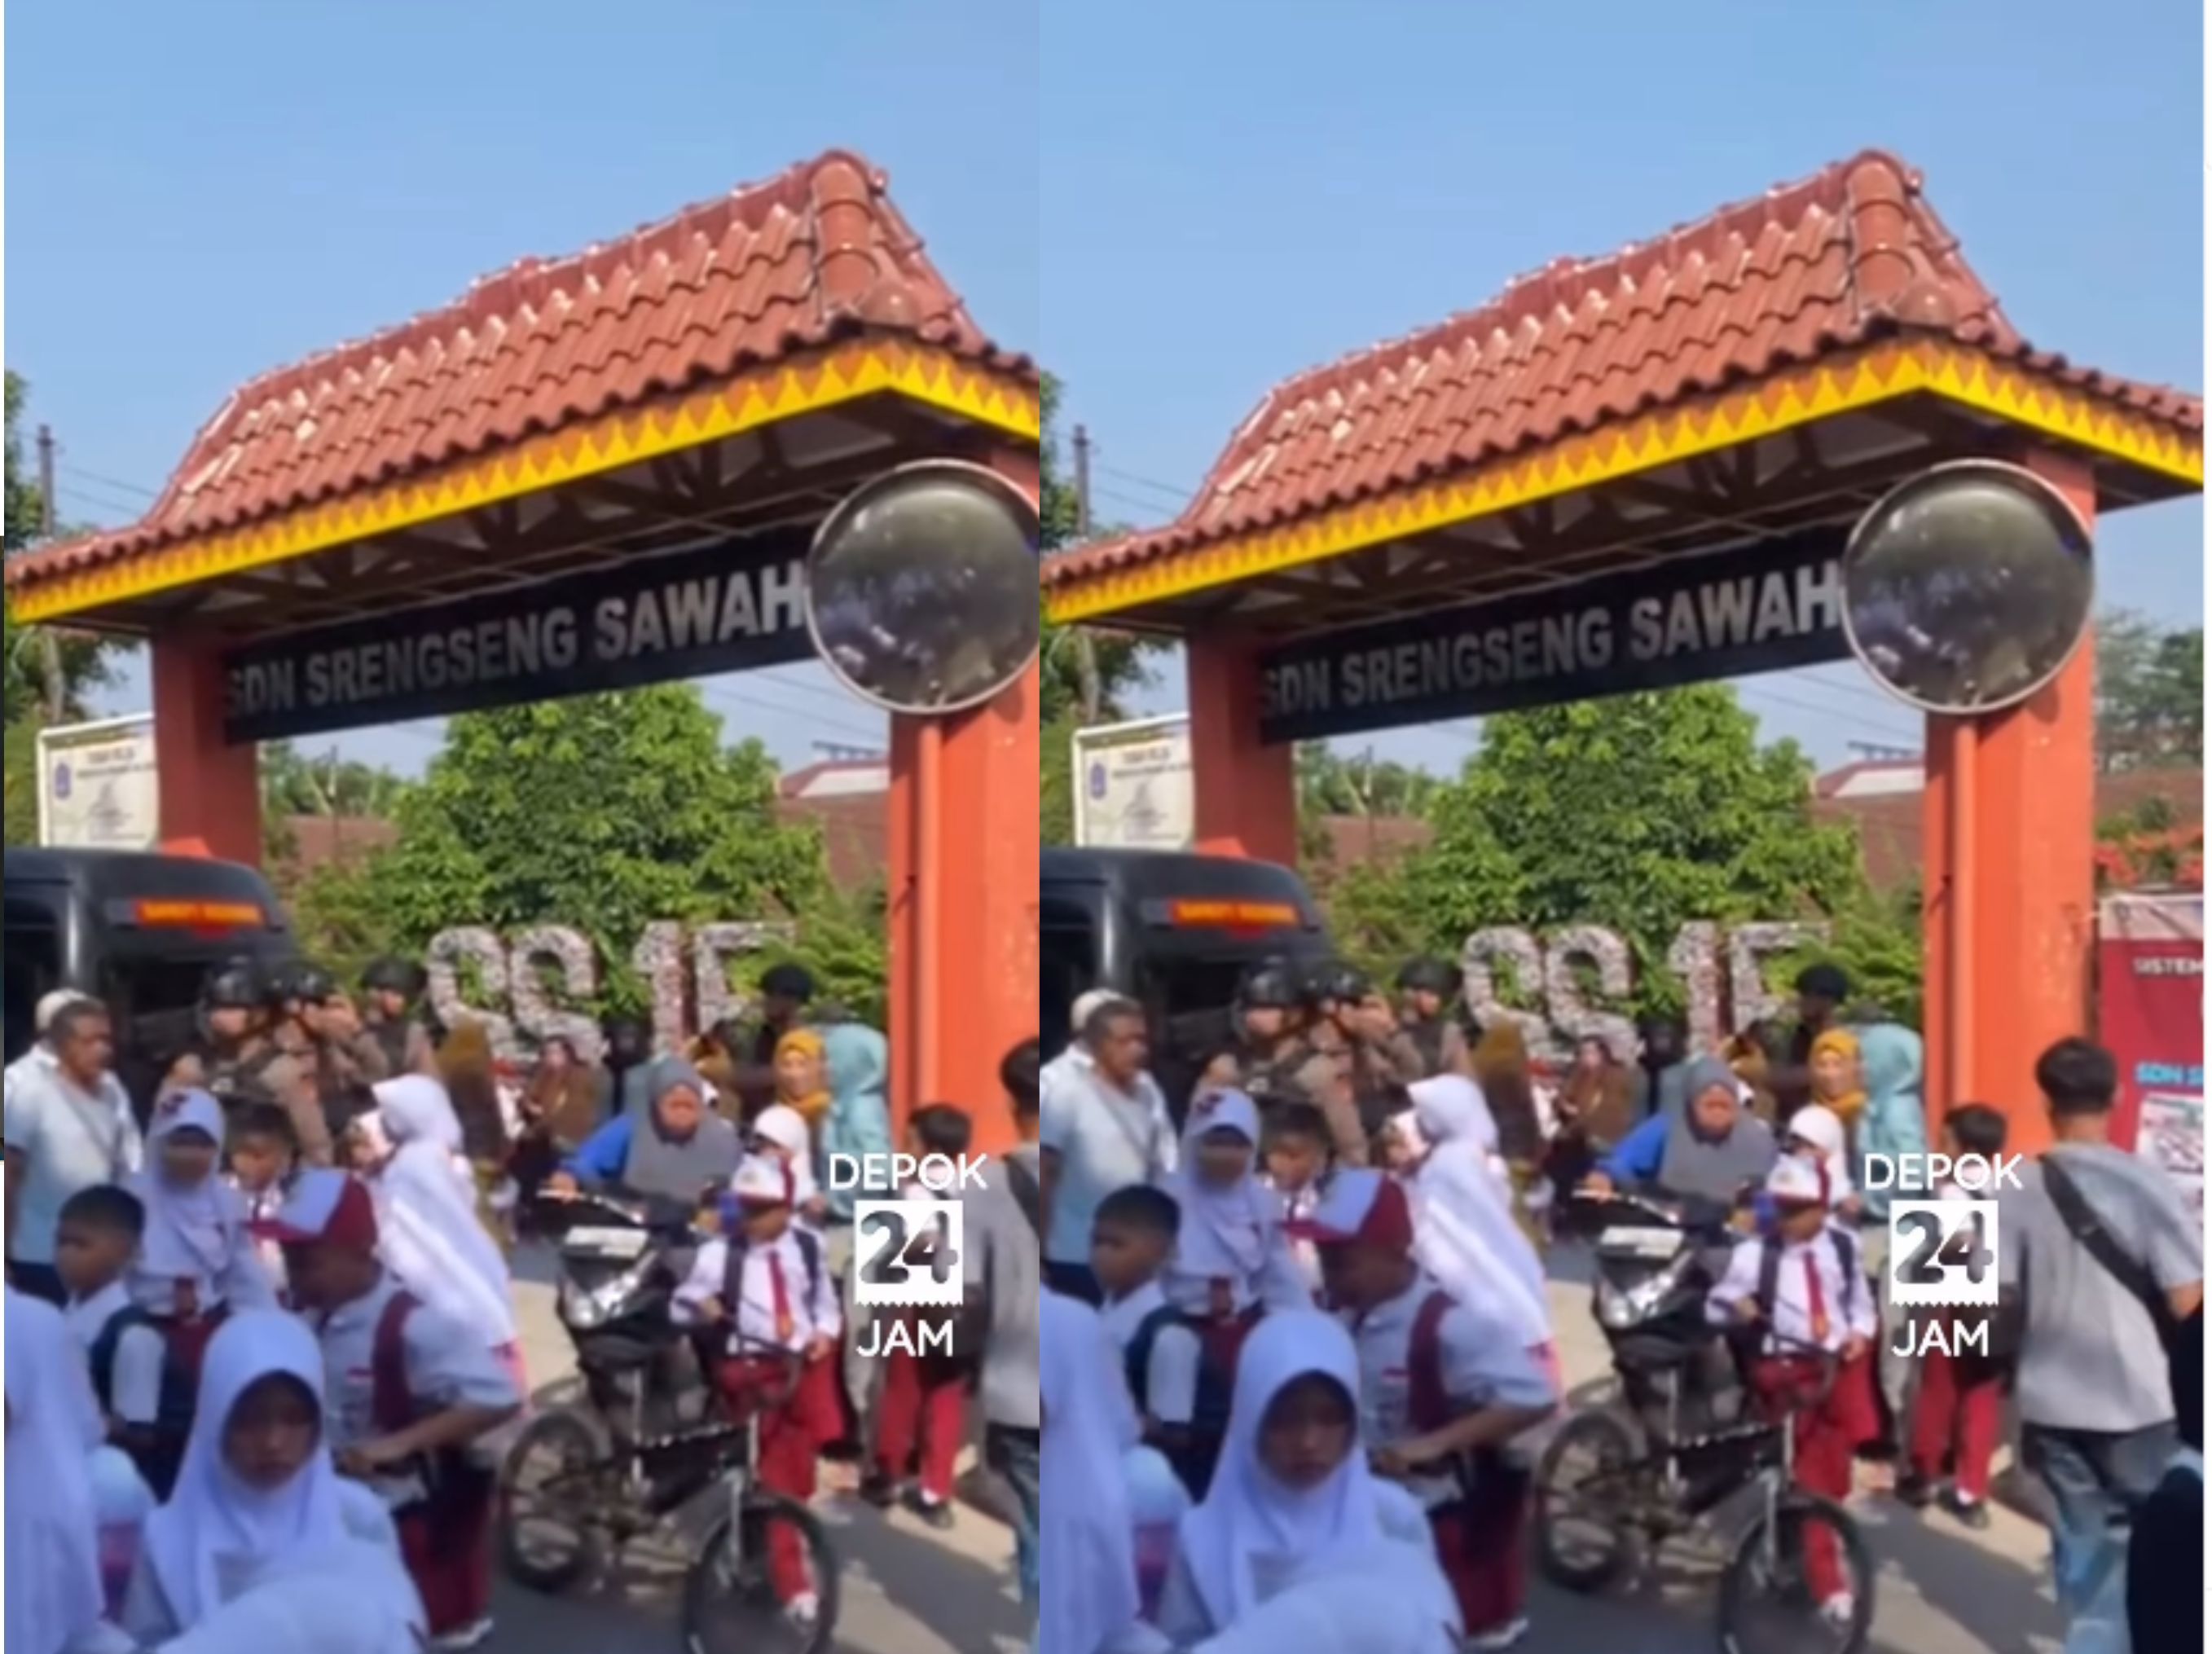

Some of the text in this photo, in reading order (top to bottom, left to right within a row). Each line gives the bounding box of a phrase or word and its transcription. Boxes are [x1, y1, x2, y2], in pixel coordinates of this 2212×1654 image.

[304, 607, 577, 704] SRENGSENG
[594, 559, 806, 660] SAWAH
[1341, 607, 1613, 704] SRENGSENG
[1629, 559, 1840, 660] SAWAH
